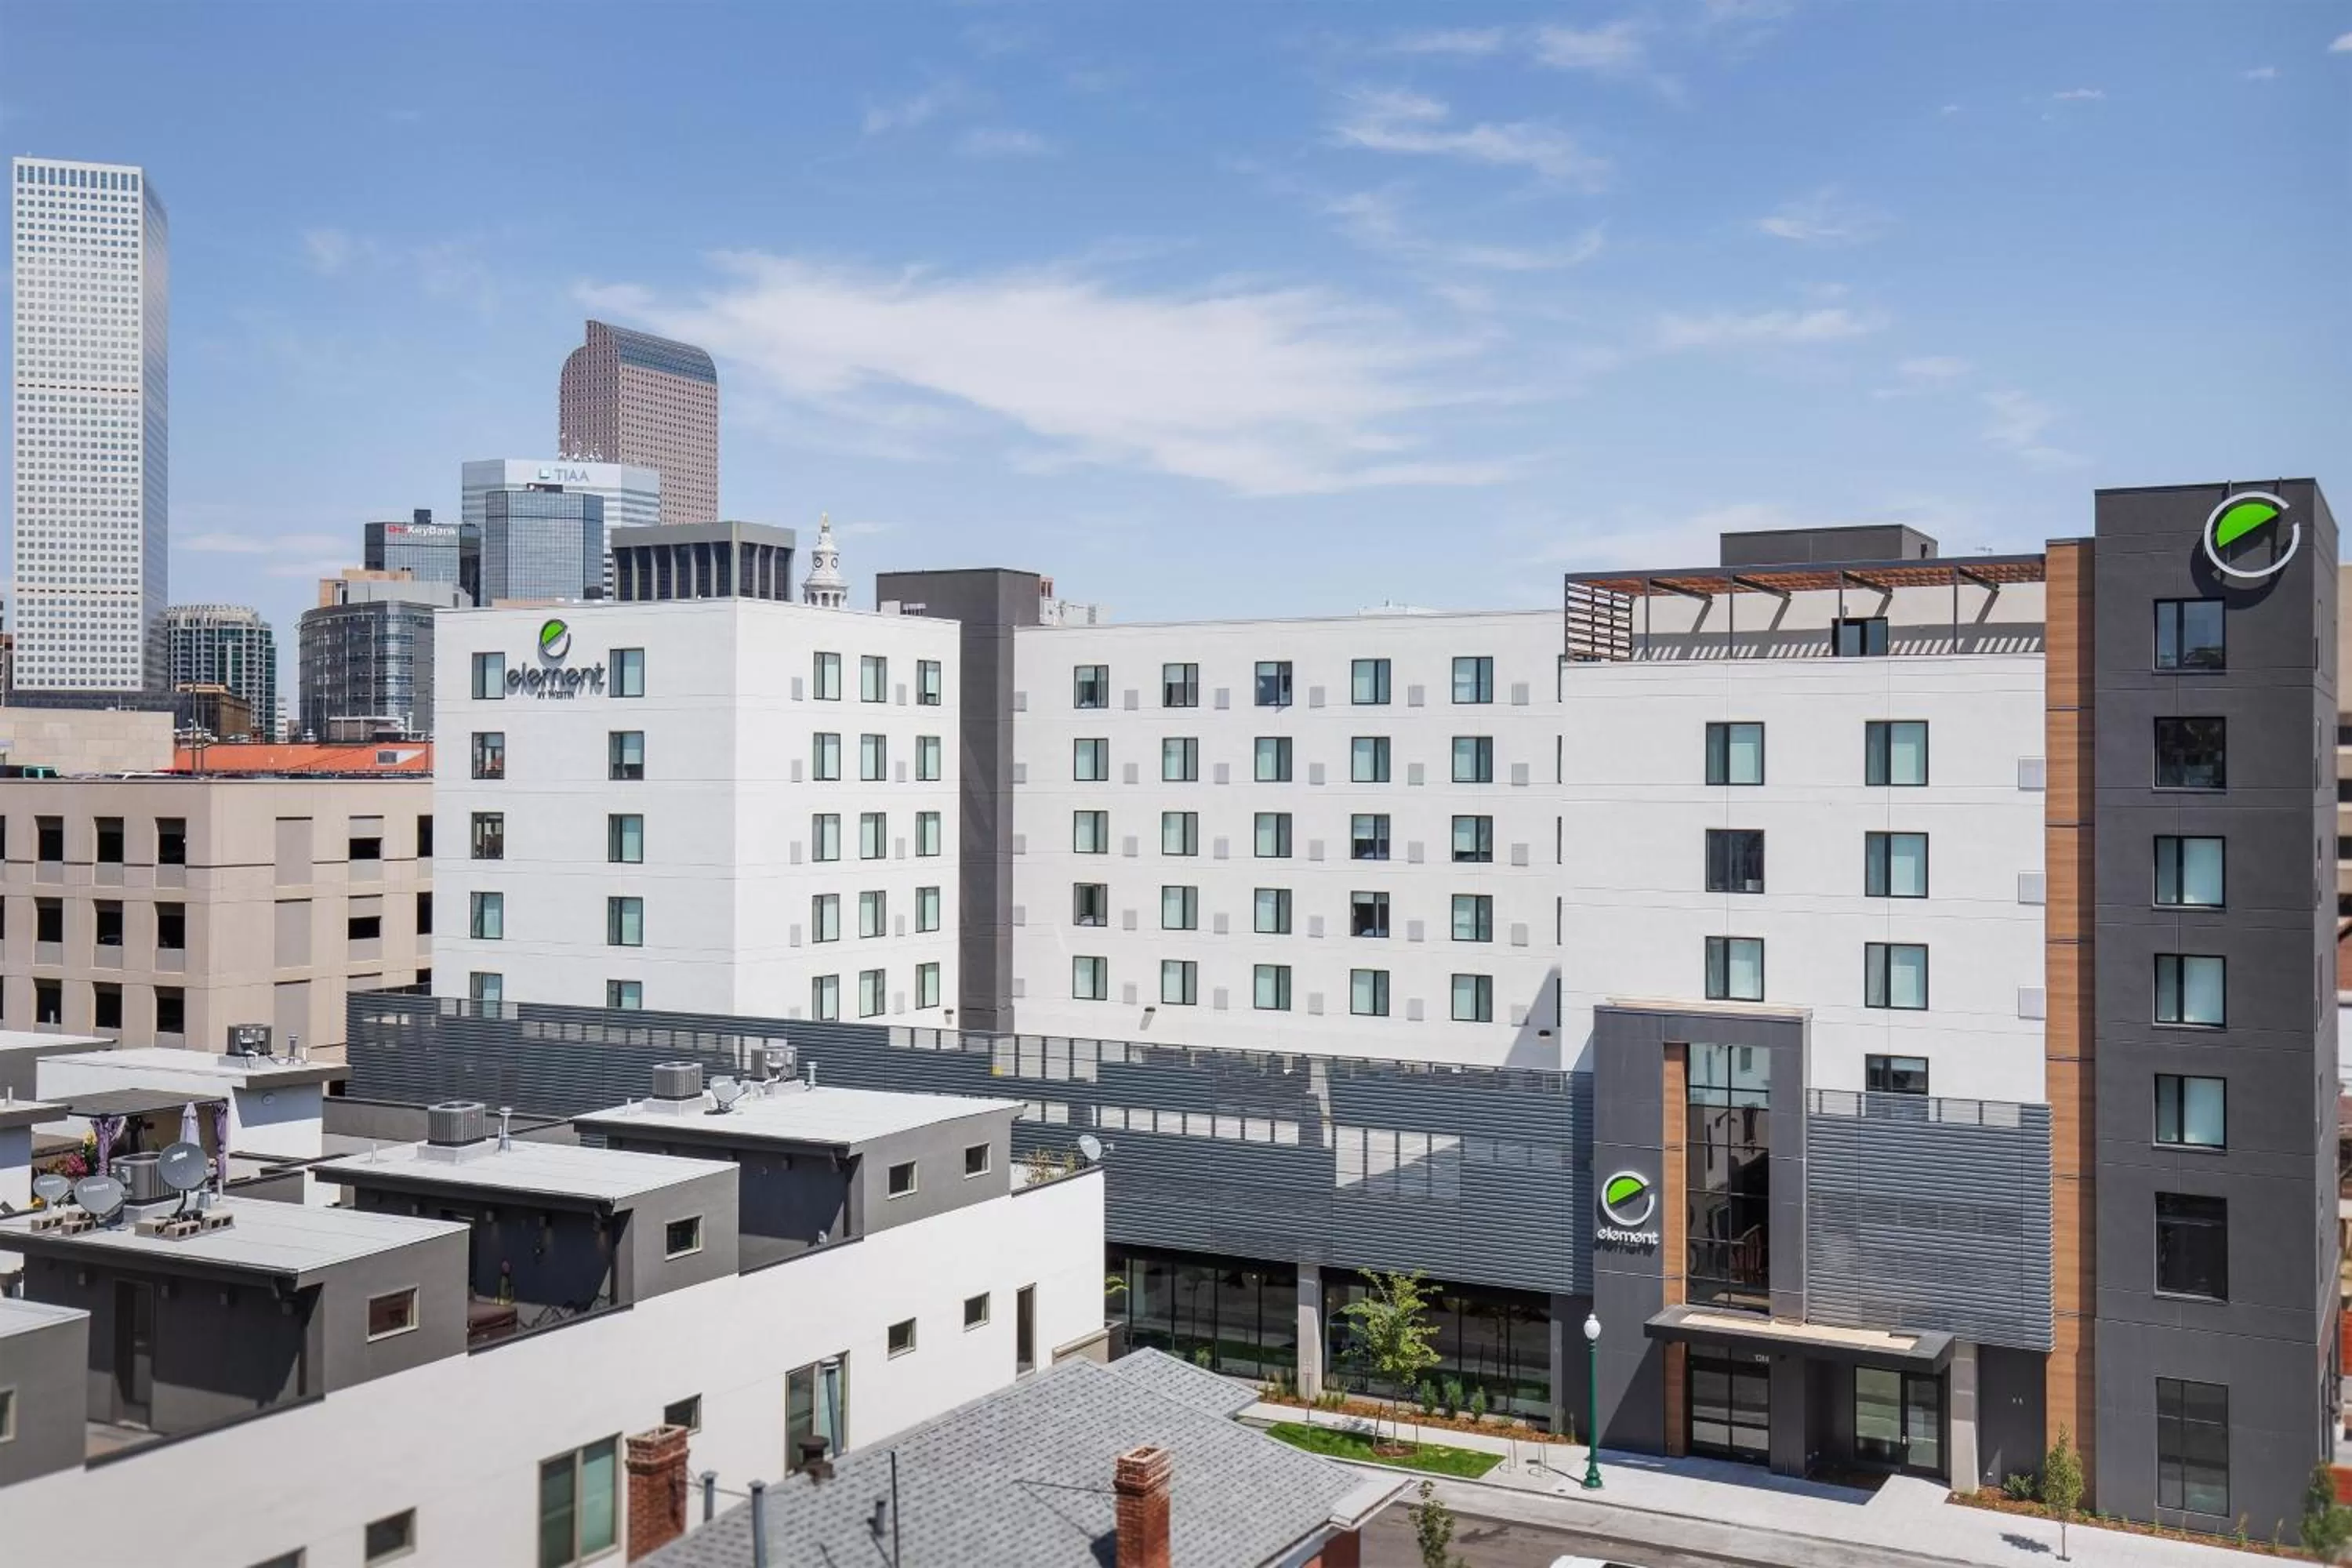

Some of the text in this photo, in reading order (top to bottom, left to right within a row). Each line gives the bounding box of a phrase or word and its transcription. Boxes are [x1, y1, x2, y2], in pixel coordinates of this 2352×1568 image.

[554, 468, 590, 481] TIAA
[407, 524, 456, 537] KeyBank
[506, 662, 606, 687] element
[1597, 1226, 1660, 1245] element
